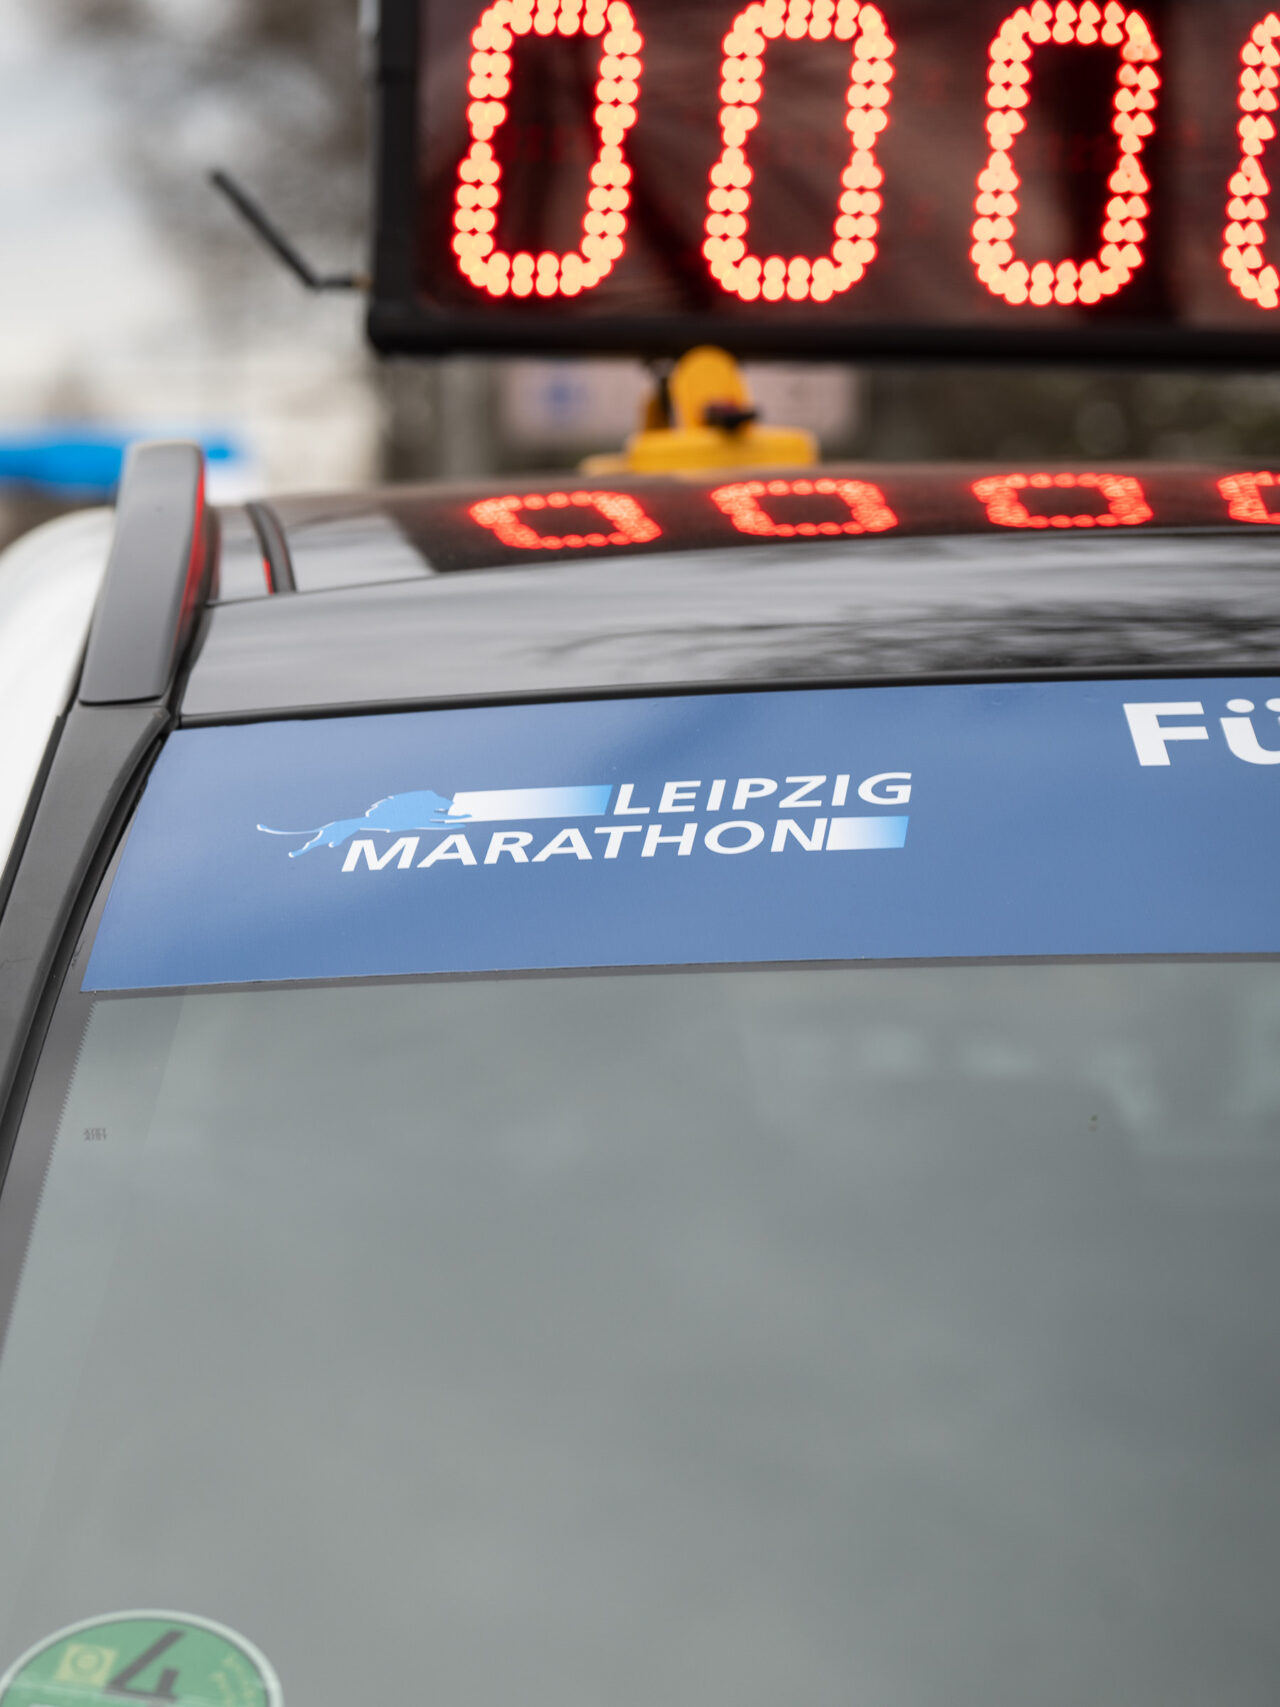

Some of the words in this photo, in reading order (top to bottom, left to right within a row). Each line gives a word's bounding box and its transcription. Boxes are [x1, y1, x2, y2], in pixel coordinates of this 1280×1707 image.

[613, 771, 912, 816] LEIPZIG
[341, 817, 828, 873] MARATHON
[104, 1629, 185, 1702] 4
